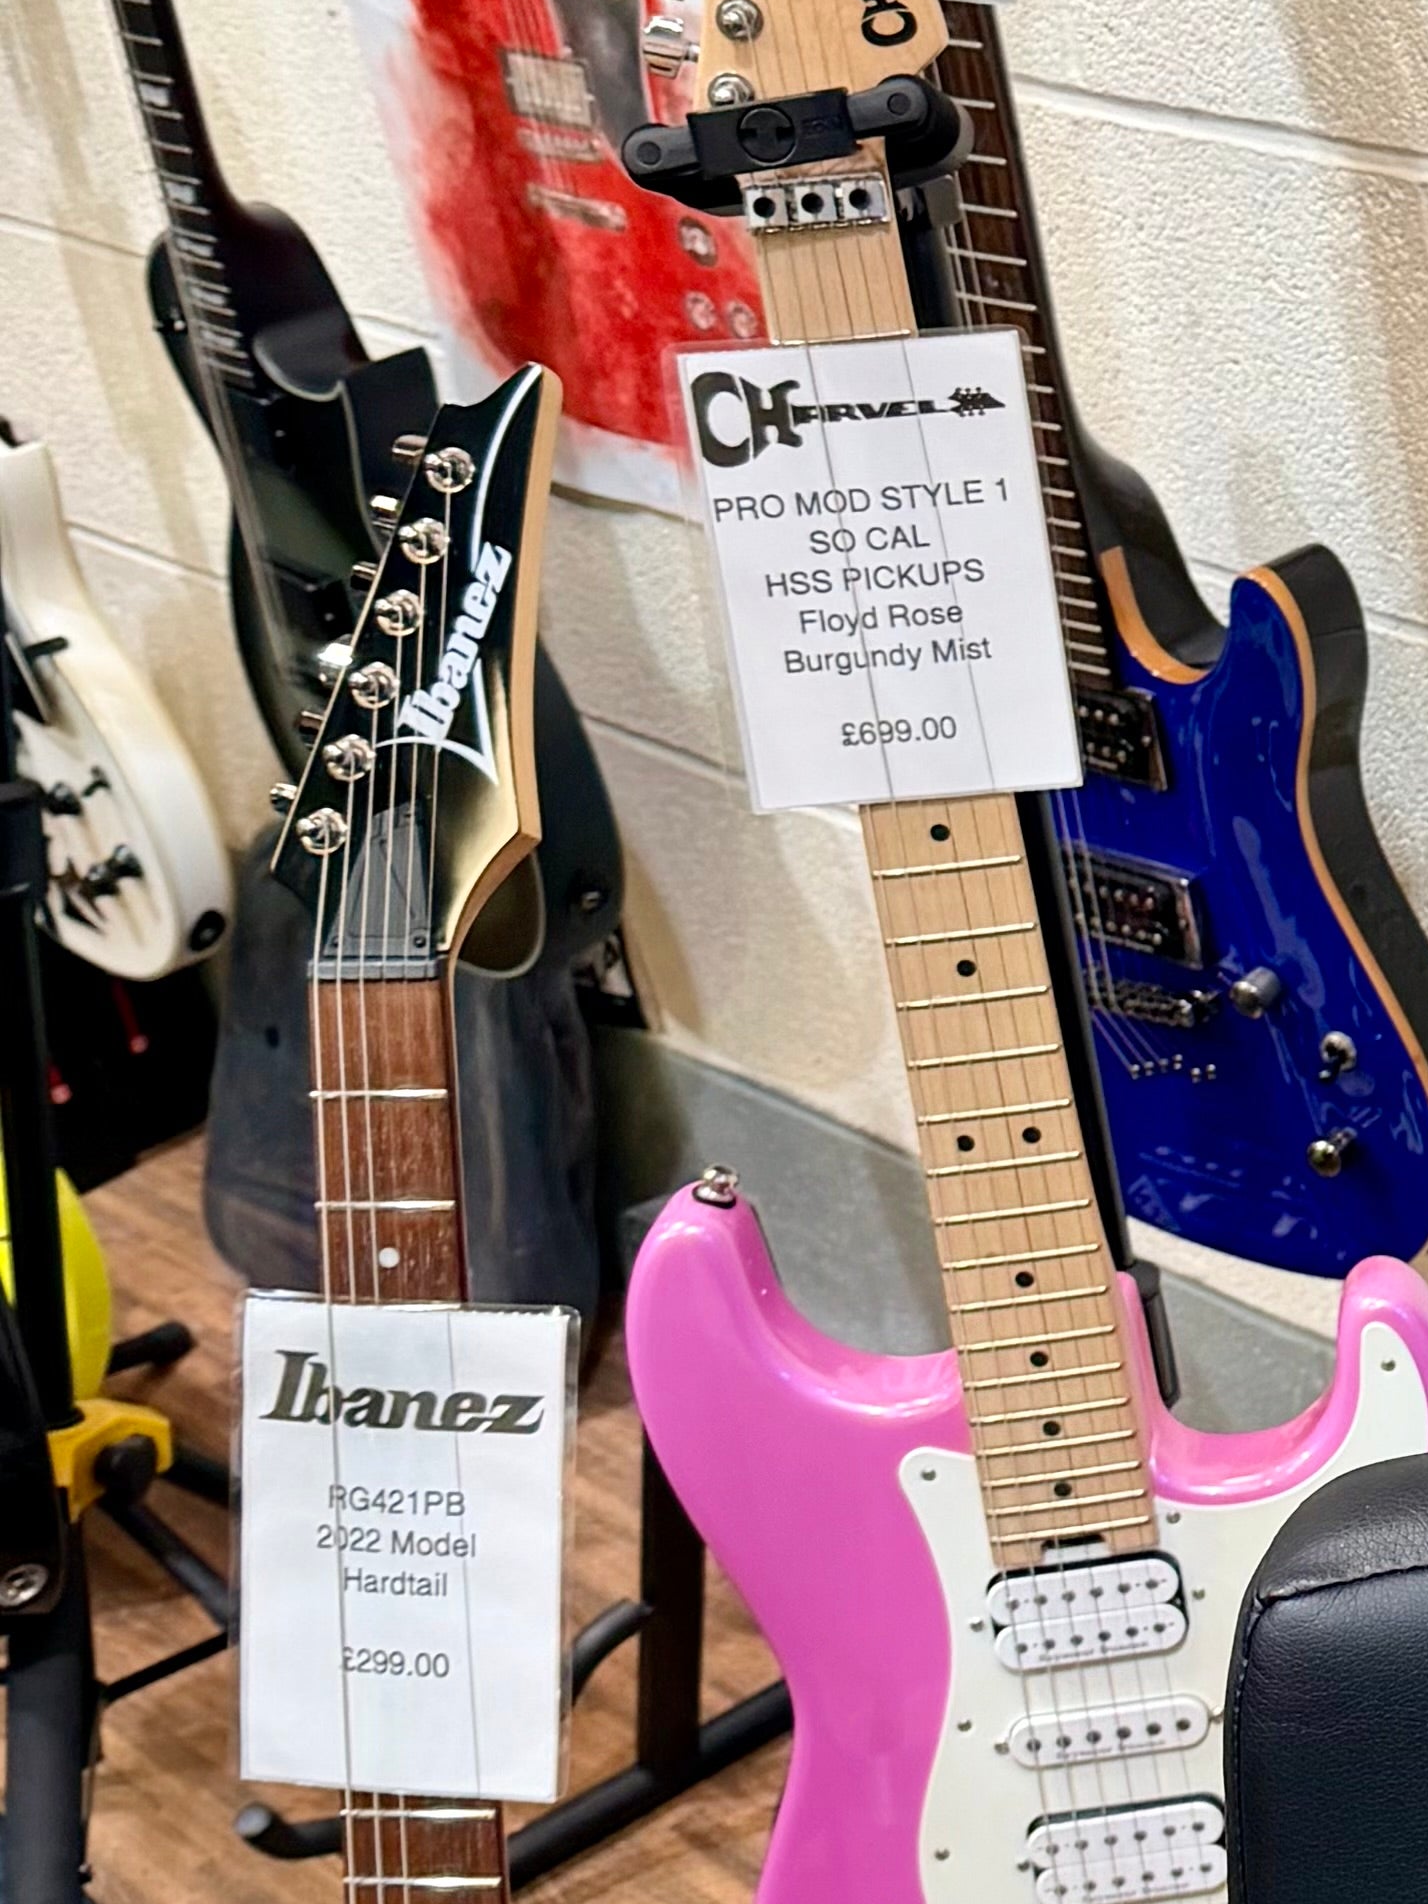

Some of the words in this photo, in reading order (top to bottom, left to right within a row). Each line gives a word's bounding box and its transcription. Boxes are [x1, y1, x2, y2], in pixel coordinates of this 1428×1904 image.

[713, 494, 785, 523] PRO
[795, 488, 871, 518] MOD
[881, 479, 984, 512] STYLE
[994, 477, 1009, 503] 1
[809, 528, 856, 555] SO
[866, 524, 931, 552] CAL
[765, 568, 833, 598] HSS
[843, 558, 986, 592] PICKUPS
[799, 605, 878, 637] Floyd
[889, 599, 964, 629] Rose
[396, 541, 513, 744] Ibanez
[784, 642, 922, 677] Burgundy
[932, 635, 992, 664] Mist
[841, 715, 958, 748] £699.00
[259, 1348, 546, 1435] Ibanez
[328, 1485, 466, 1518] RG421PB
[317, 1523, 382, 1554] 2022
[391, 1529, 477, 1558] Model
[342, 1566, 449, 1598] Hardtail
[341, 1647, 450, 1679] £299.00
